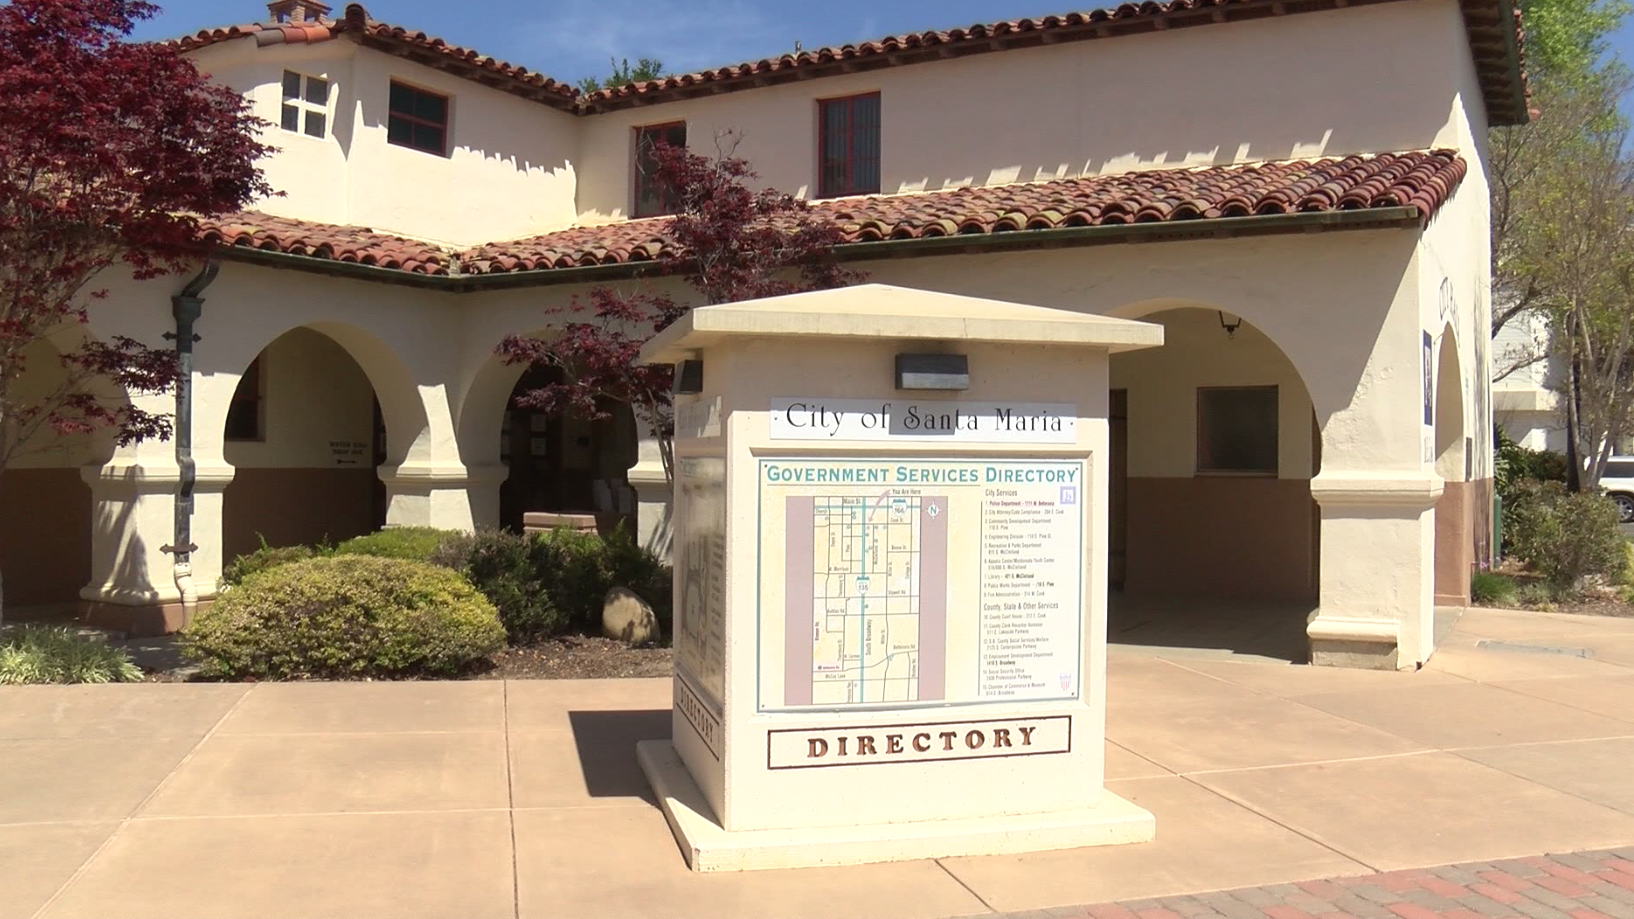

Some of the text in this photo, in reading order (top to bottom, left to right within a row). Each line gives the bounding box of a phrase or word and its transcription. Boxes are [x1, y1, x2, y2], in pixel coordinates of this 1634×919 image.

[786, 402, 1062, 436] City of Santa Maria
[985, 488, 1017, 498] City Services
[807, 726, 1036, 758] DIRECTORY
